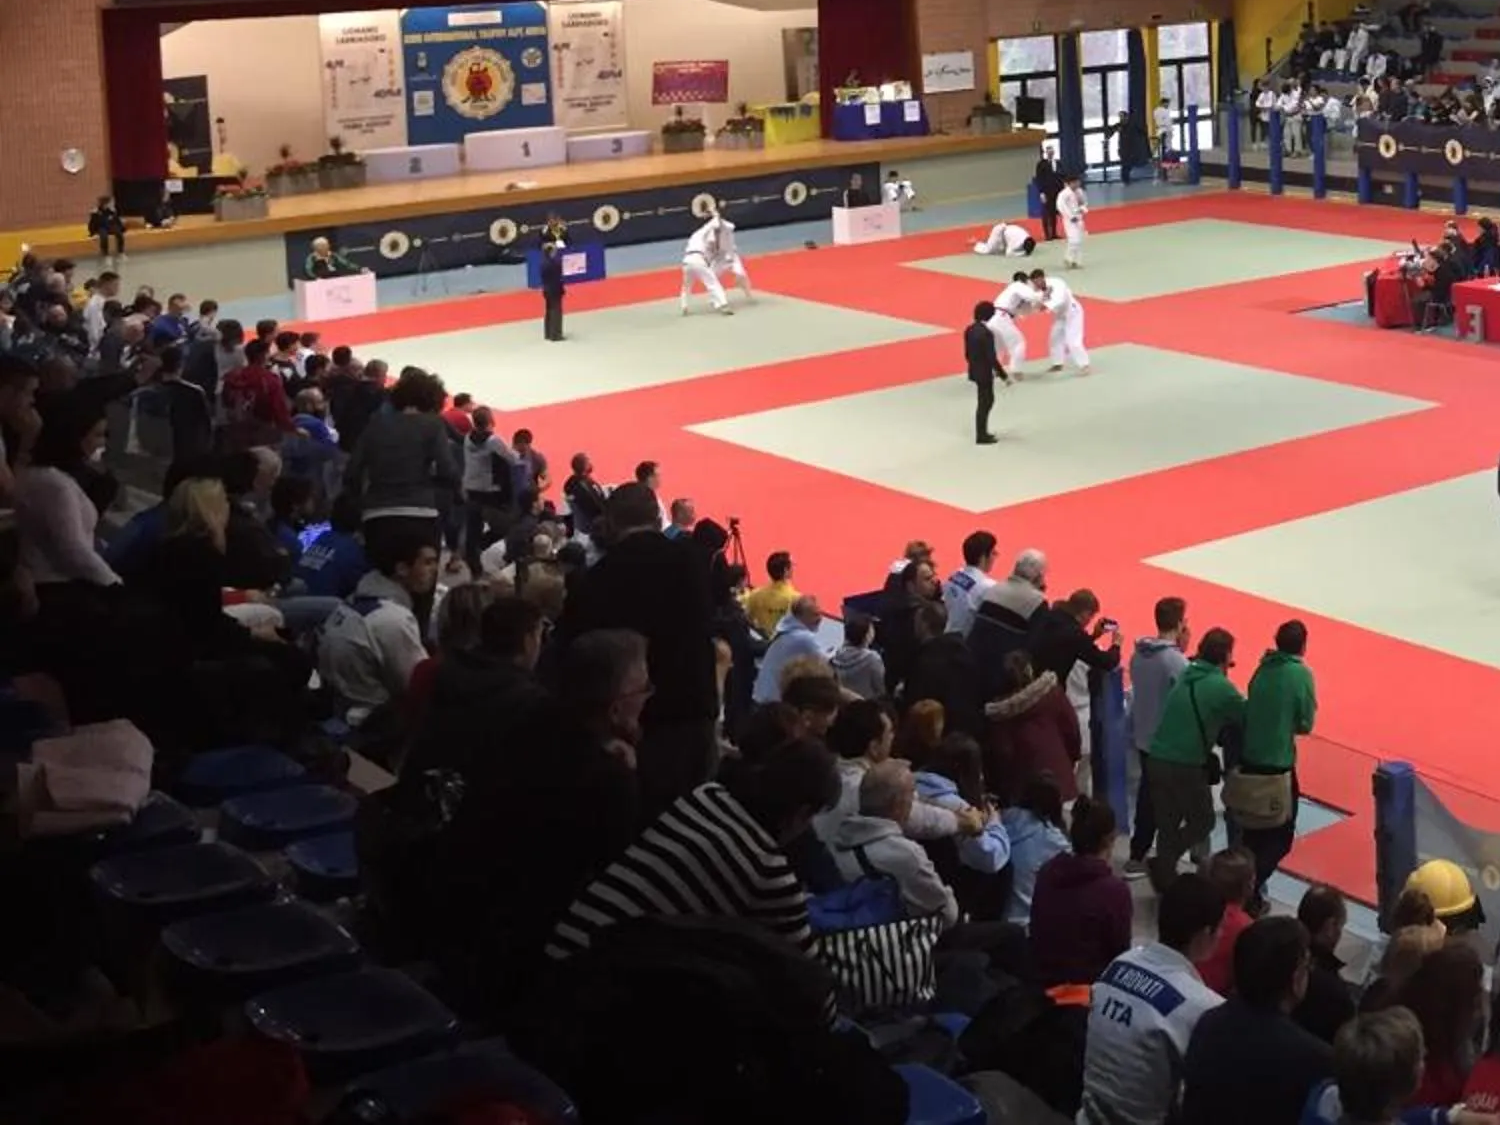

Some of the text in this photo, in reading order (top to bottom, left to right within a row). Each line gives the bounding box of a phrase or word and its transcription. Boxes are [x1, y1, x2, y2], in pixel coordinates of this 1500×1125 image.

[520, 140, 531, 158] 1
[408, 156, 422, 174] 2
[1101, 995, 1132, 1027] ITA
